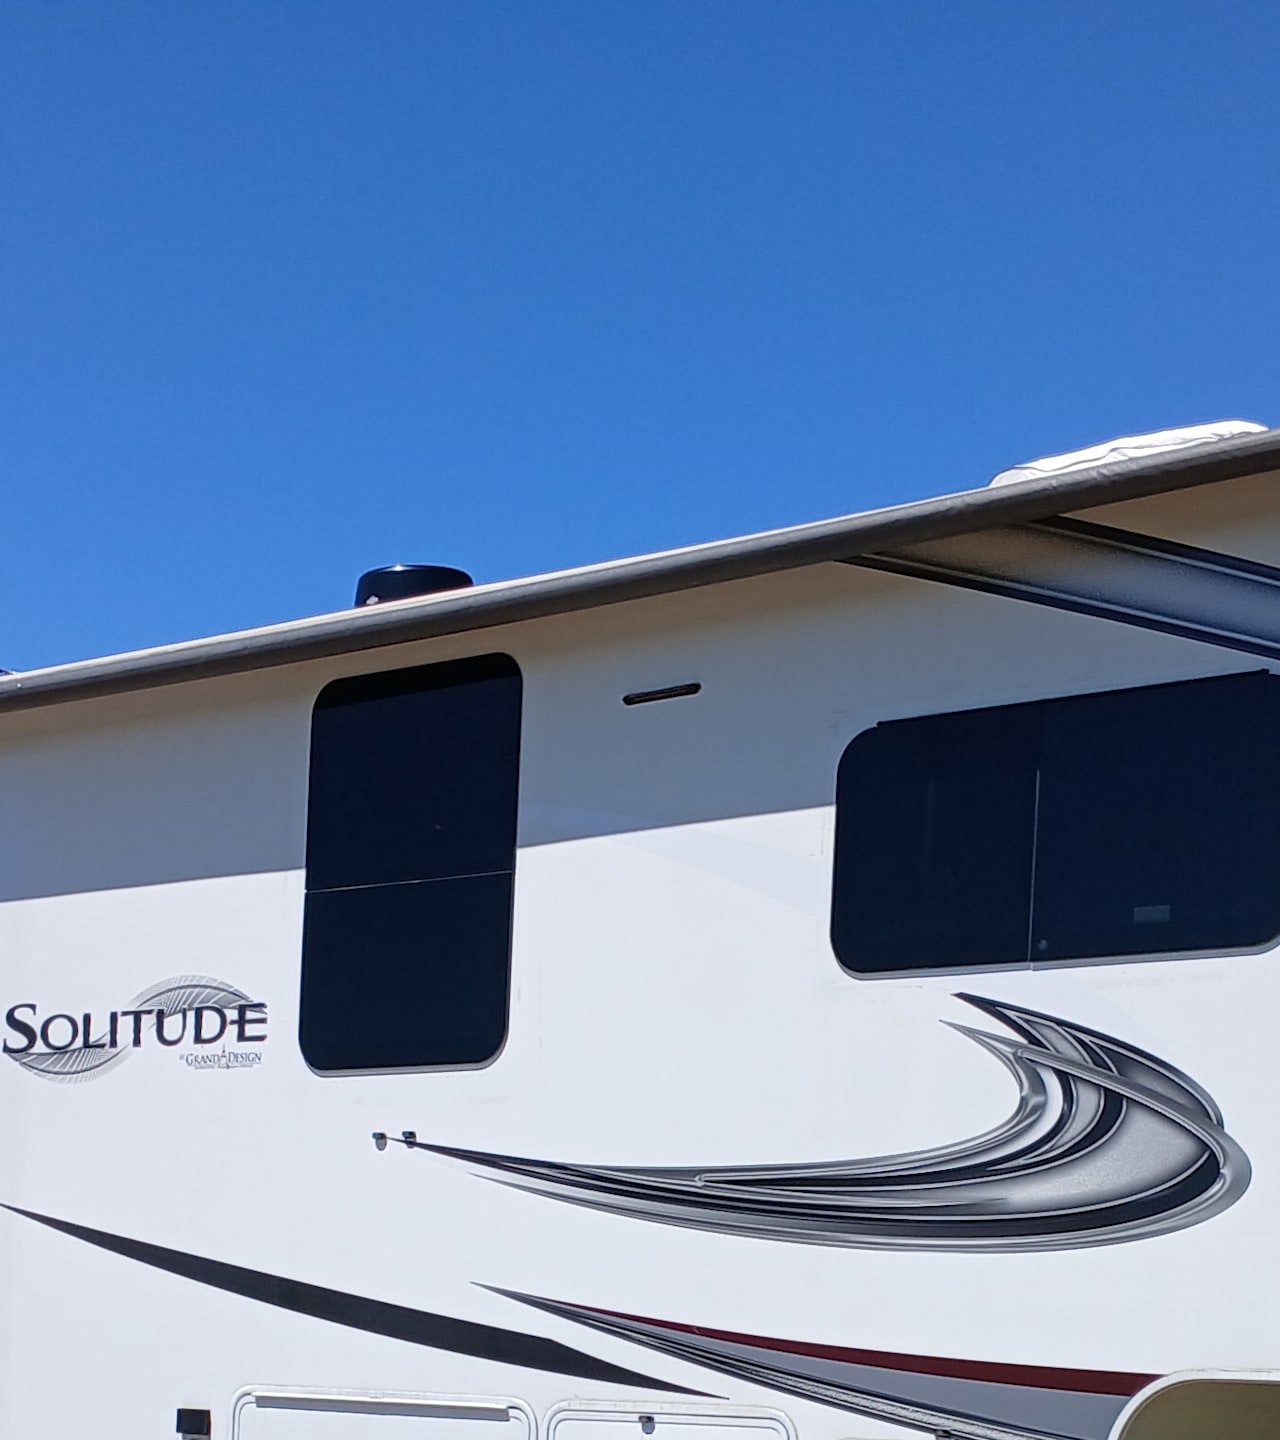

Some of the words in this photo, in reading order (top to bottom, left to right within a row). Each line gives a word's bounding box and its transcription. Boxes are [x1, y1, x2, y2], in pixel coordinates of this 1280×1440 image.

[2, 1003, 268, 1053] SOLITUDE
[186, 1053, 220, 1066] GRAND
[228, 1051, 261, 1064] DESIGN
